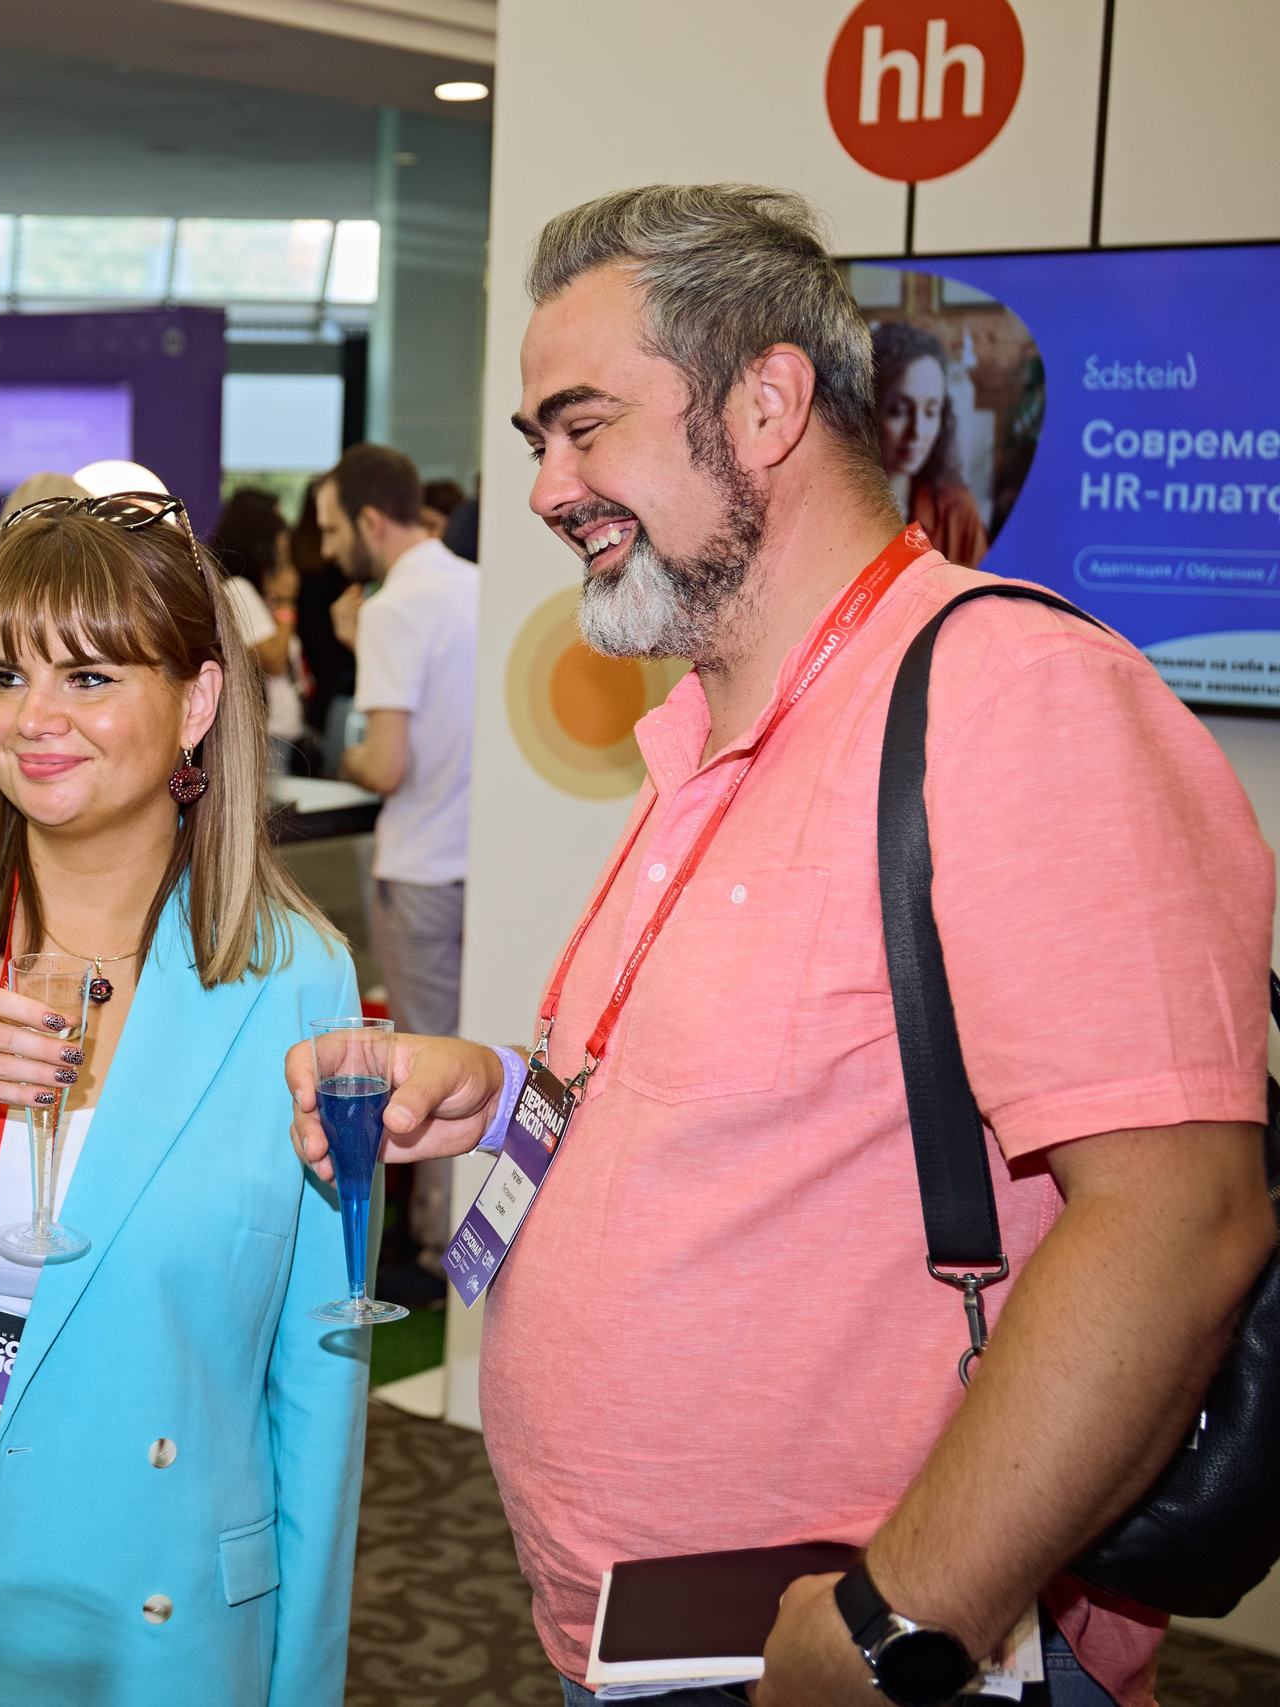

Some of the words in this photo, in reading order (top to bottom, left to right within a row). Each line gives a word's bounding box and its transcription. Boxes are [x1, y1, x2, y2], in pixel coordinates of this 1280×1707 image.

[858, 18, 986, 126] hh
[1082, 352, 1198, 391] Edstein
[1081, 418, 1280, 469] Совреме
[789, 633, 840, 704] ПЕРСОНАЛ
[842, 592, 867, 624] ЭКСПО
[615, 932, 654, 1002] ПЕРСОНАЛ
[515, 1102, 544, 1141] ЭКСПО
[521, 1084, 565, 1137] ПЕРСОНАЛ
[461, 1227, 482, 1258] ПЕРСОНАЛ
